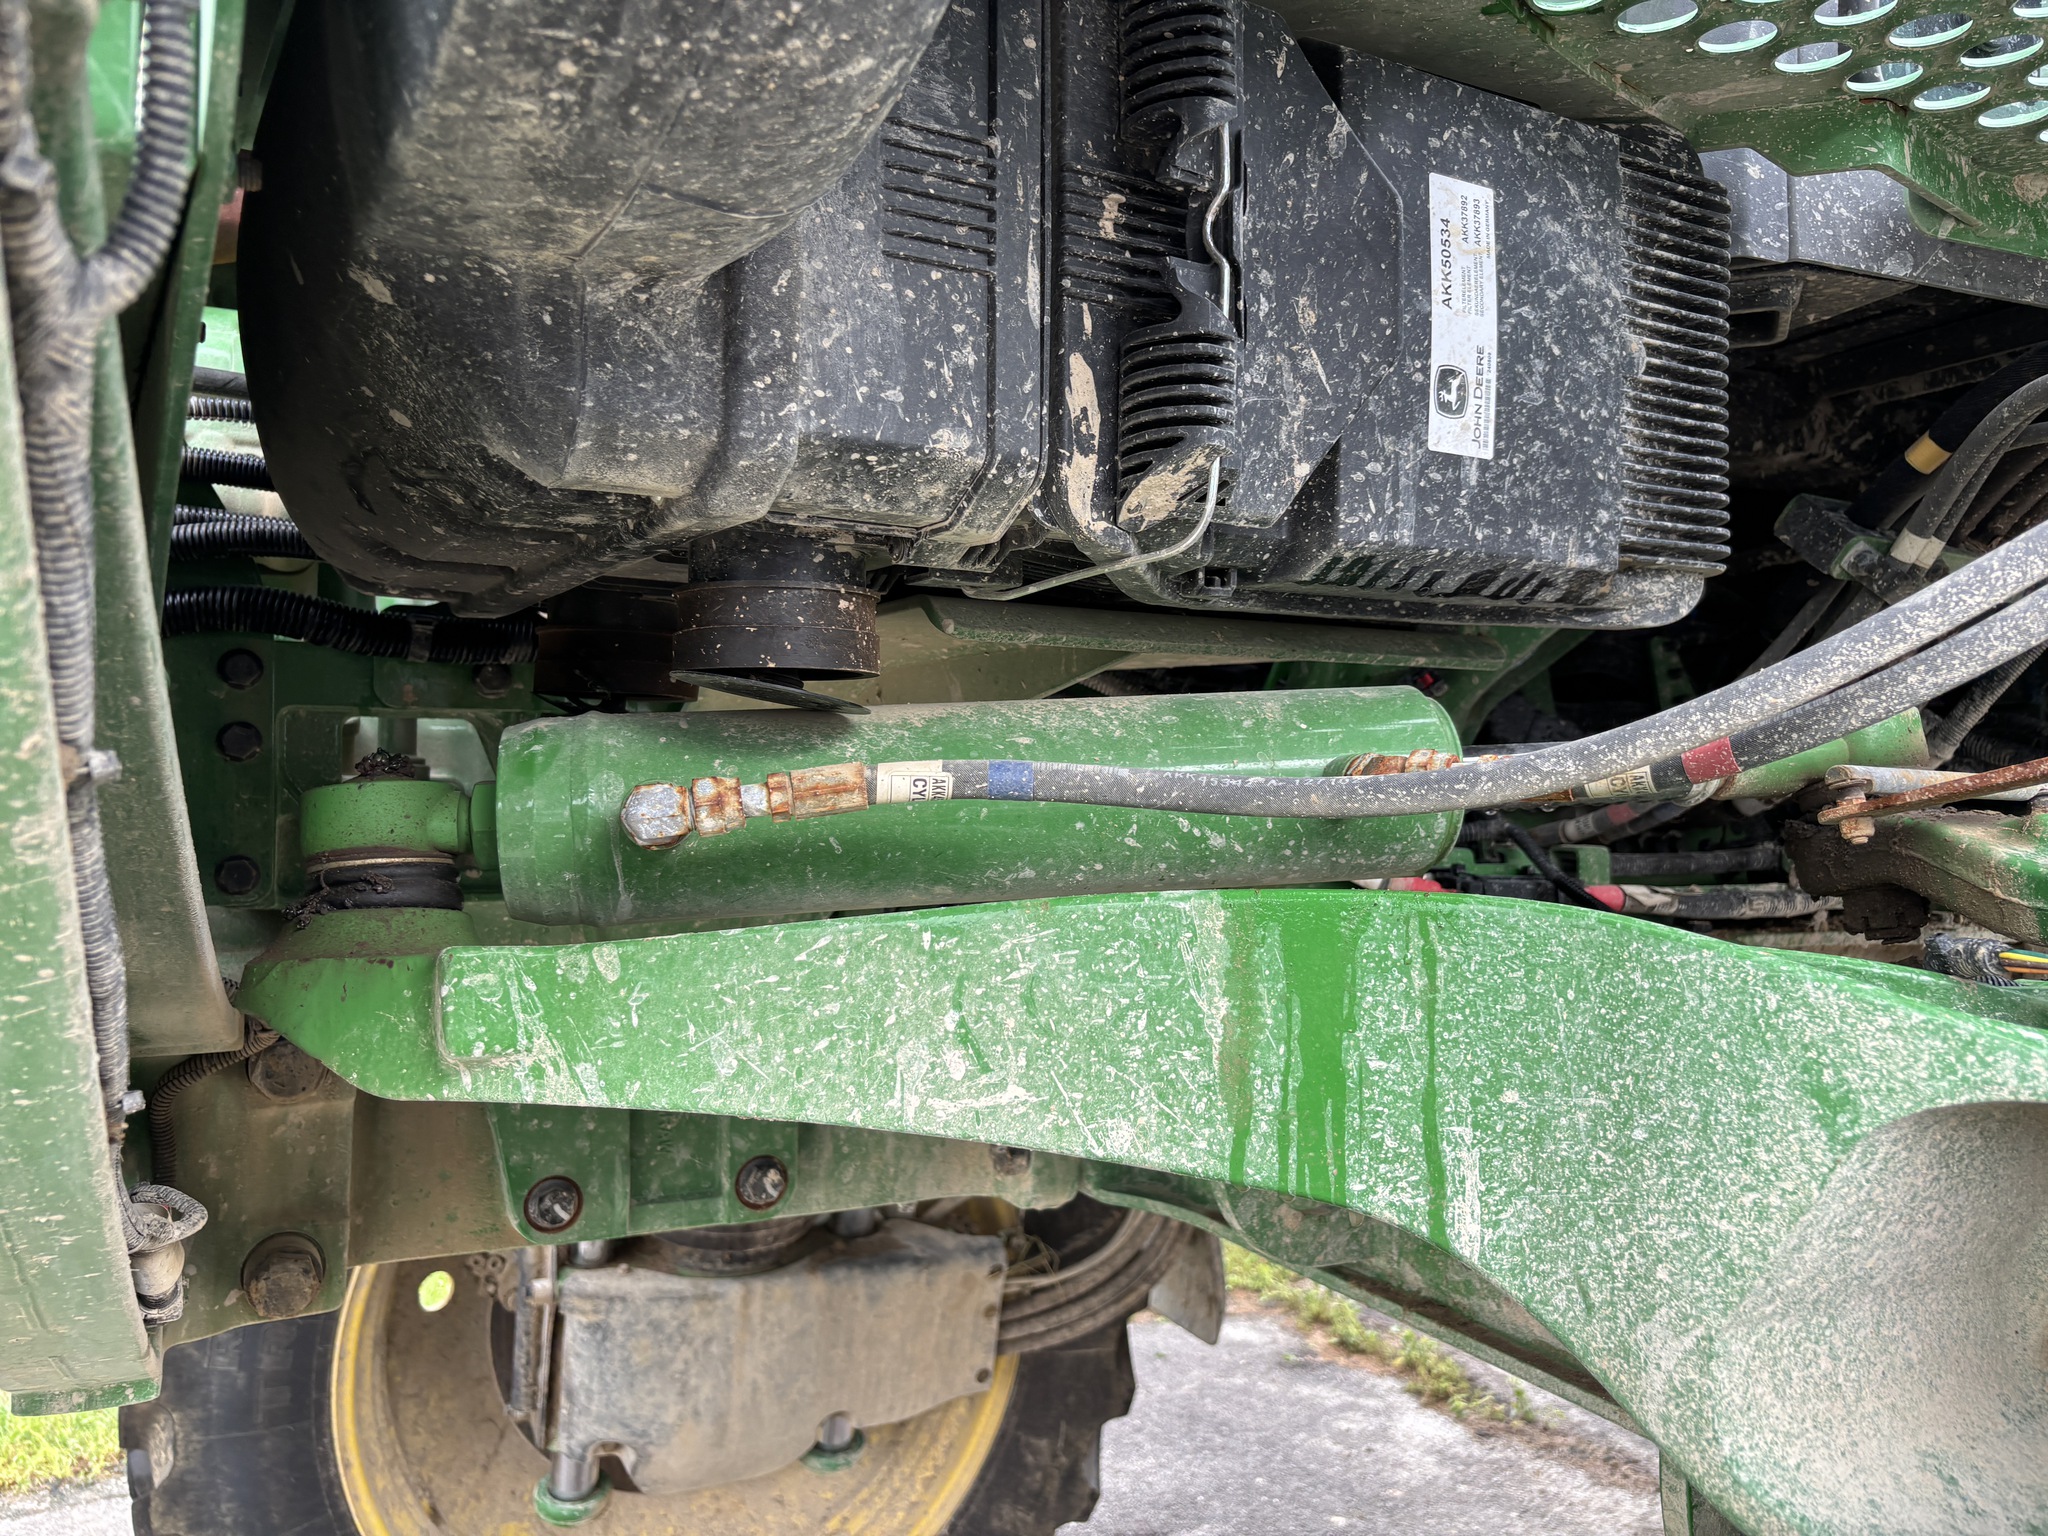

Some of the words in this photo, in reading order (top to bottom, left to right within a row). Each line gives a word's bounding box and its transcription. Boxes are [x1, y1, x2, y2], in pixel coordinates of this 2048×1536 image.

[1460, 194, 1469, 244] AKK37892
[1472, 198, 1482, 248] AKK37893
[1440, 217, 1453, 310] AKK50534
[1473, 345, 1484, 400] DEERE
[1472, 404, 1483, 449] JOHN
